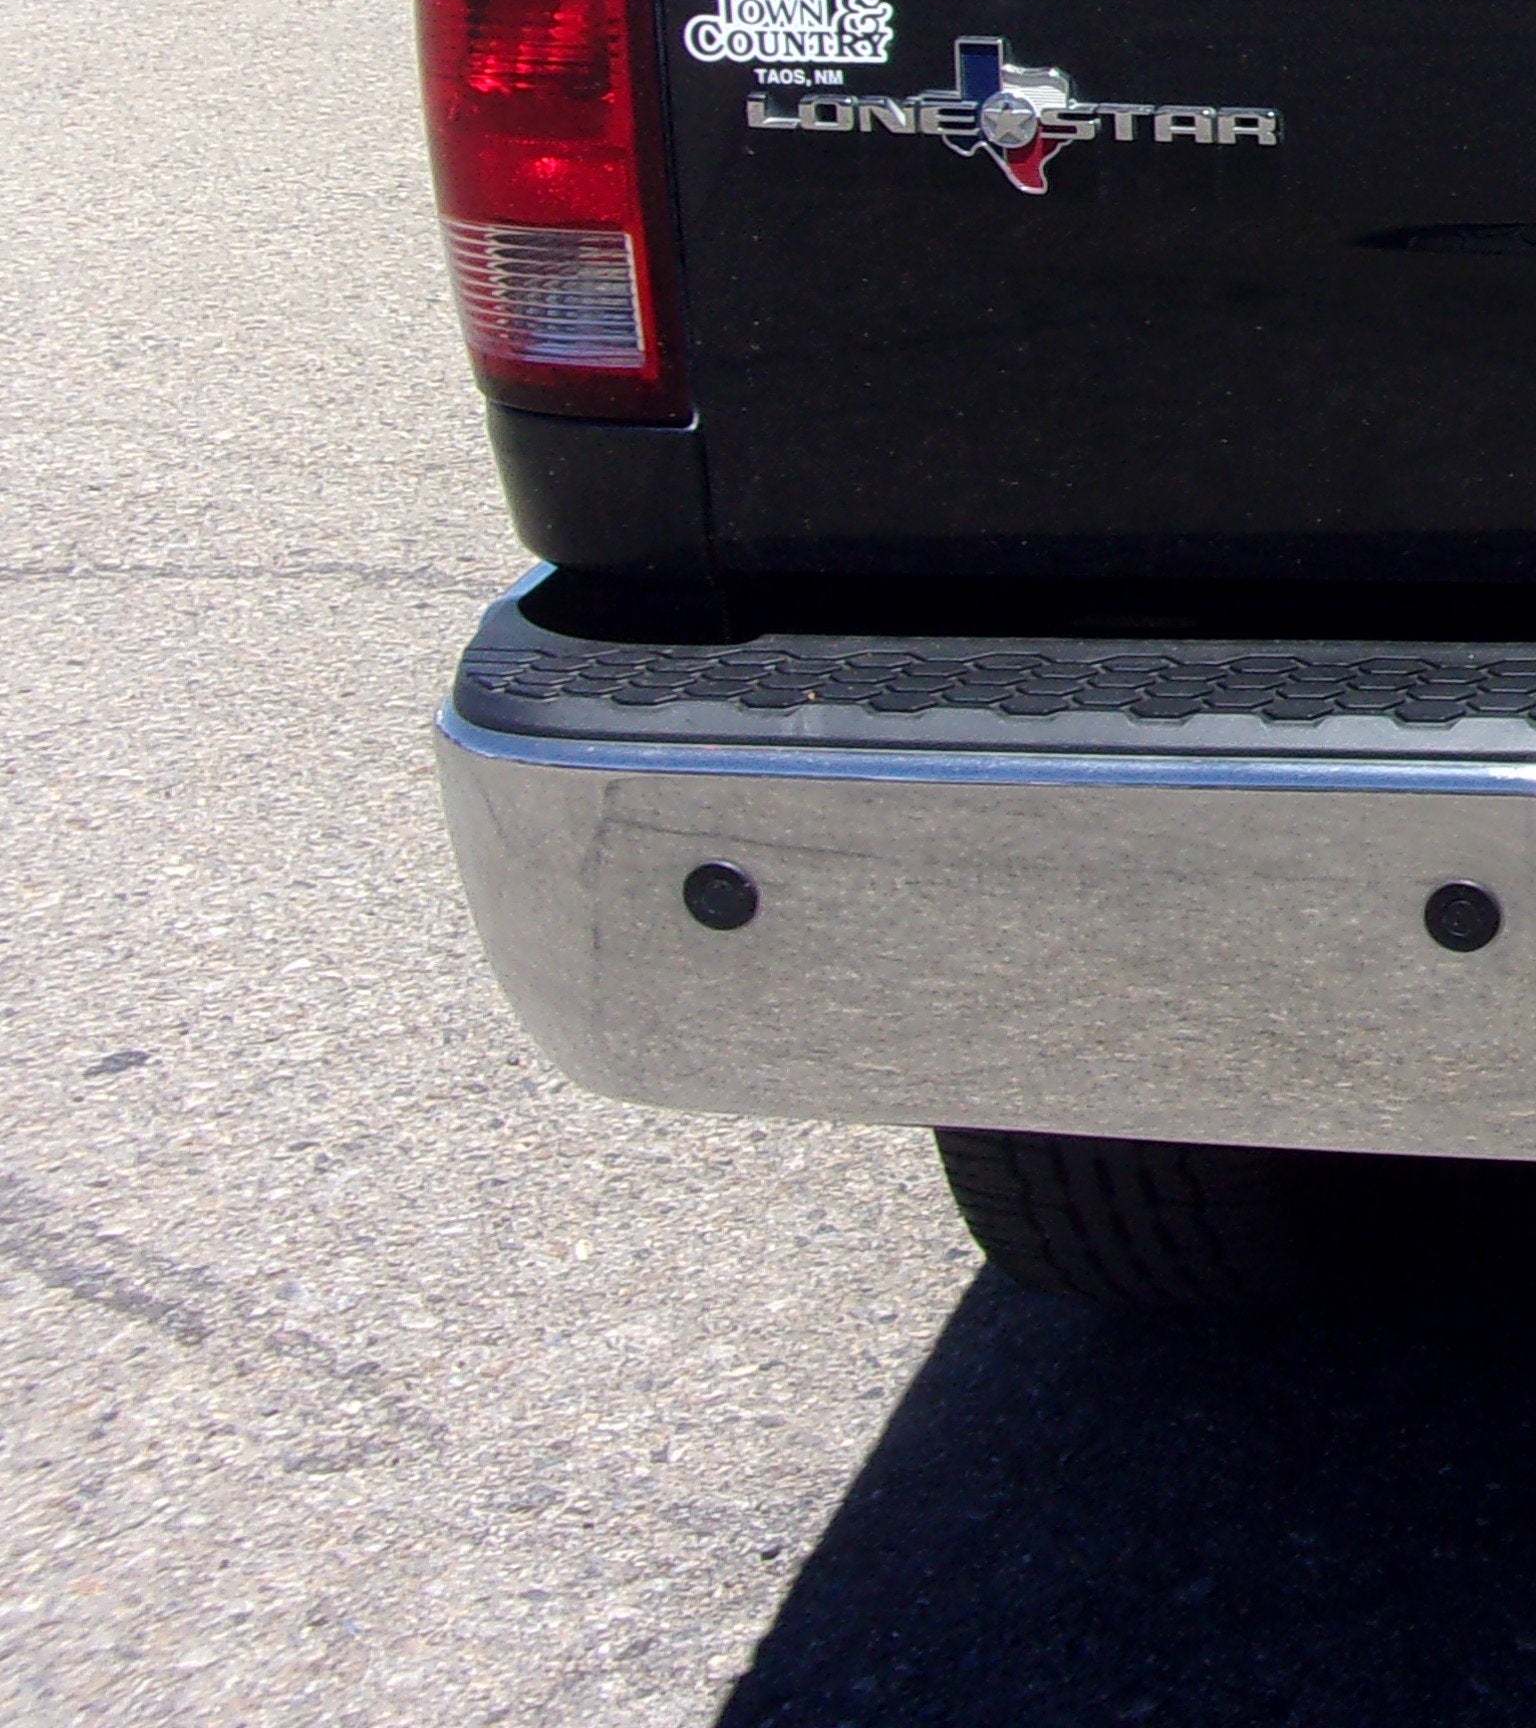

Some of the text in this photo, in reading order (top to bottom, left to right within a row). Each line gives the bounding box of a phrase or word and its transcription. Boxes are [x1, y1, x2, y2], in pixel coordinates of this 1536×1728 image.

[685, 21, 893, 64] COUNTRY
[755, 69, 844, 87] TAOS, NM
[746, 91, 1284, 146] LONE STAR
